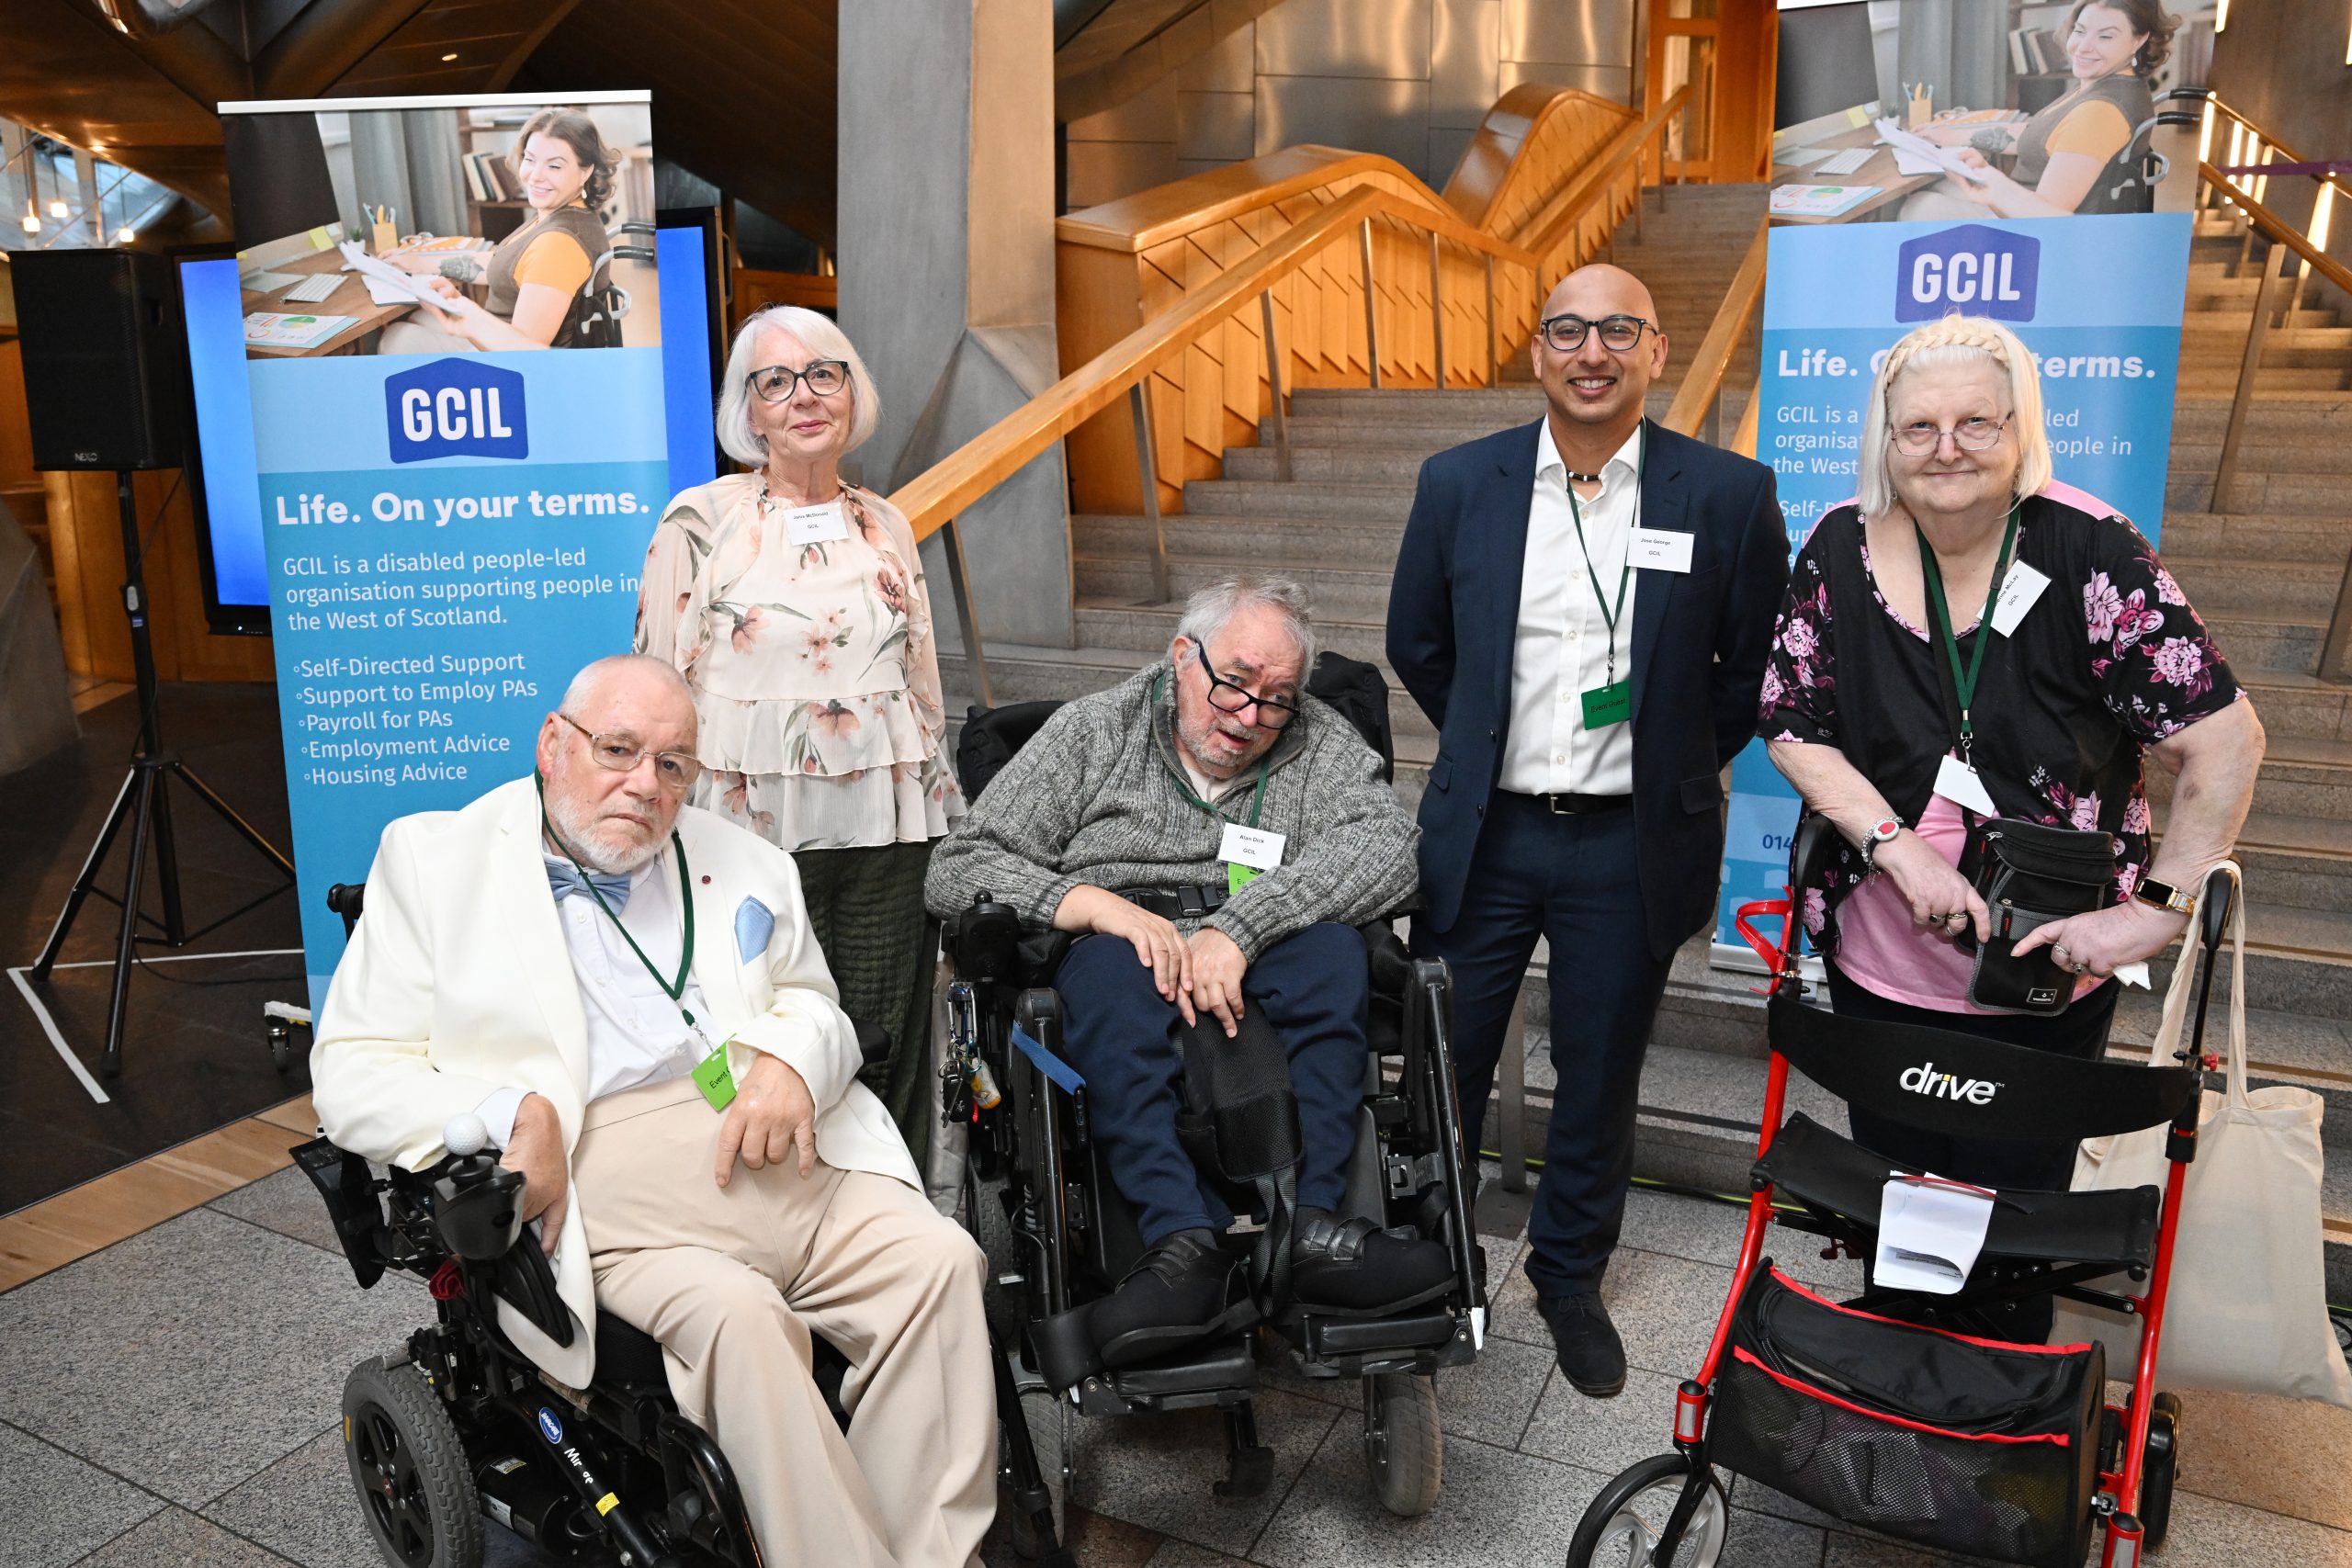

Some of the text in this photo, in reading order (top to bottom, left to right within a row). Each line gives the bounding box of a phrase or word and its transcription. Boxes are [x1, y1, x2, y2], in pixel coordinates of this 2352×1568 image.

[1912, 252, 2021, 303] GCIL
[1779, 347, 1859, 378] Life.
[401, 387, 513, 442] GCIL
[1777, 405, 1859, 423] GCIL is a
[2045, 435, 2104, 459] eople
[2111, 435, 2132, 456] in
[1773, 456, 1859, 475] the West
[277, 490, 650, 527] Life. On your terms.
[283, 547, 586, 576] GCIL is a disabled people-led
[286, 572, 639, 607] organisation supporting people in
[287, 604, 507, 631] the West of Scotland.
[300, 653, 526, 678] Self-Directed Support
[303, 679, 538, 708] Support to Employ PAs
[307, 709, 453, 736] Payroll for PAs
[309, 733, 510, 761] Employment Advice
[312, 761, 468, 787] Housing Advice
[1762, 834, 1792, 851] 014
[709, 1071, 728, 1089] Event
